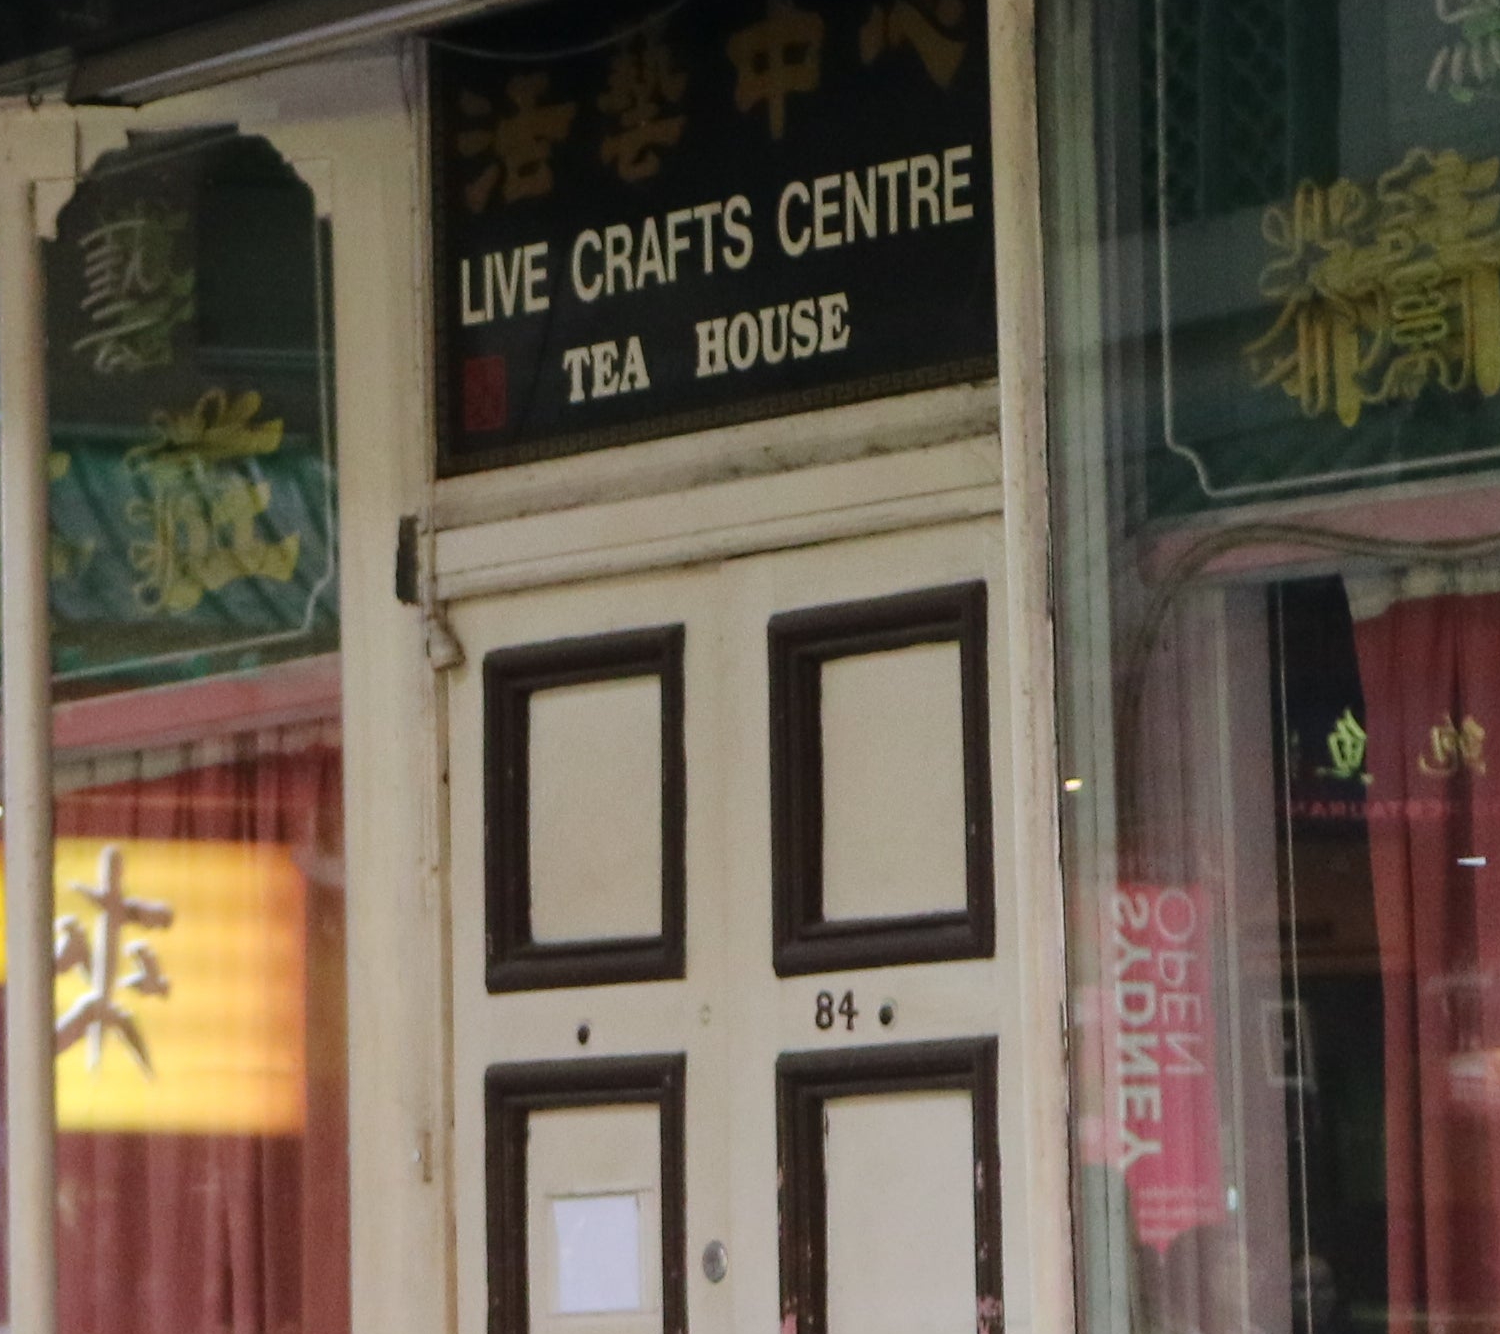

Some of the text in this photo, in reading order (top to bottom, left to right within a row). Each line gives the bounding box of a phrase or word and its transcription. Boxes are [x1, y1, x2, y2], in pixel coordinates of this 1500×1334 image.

[461, 145, 974, 325] LIVE CRAFTS CENTRE
[562, 336, 650, 403] TEA
[695, 292, 851, 378] HOUSE
[815, 989, 859, 1030] 84
